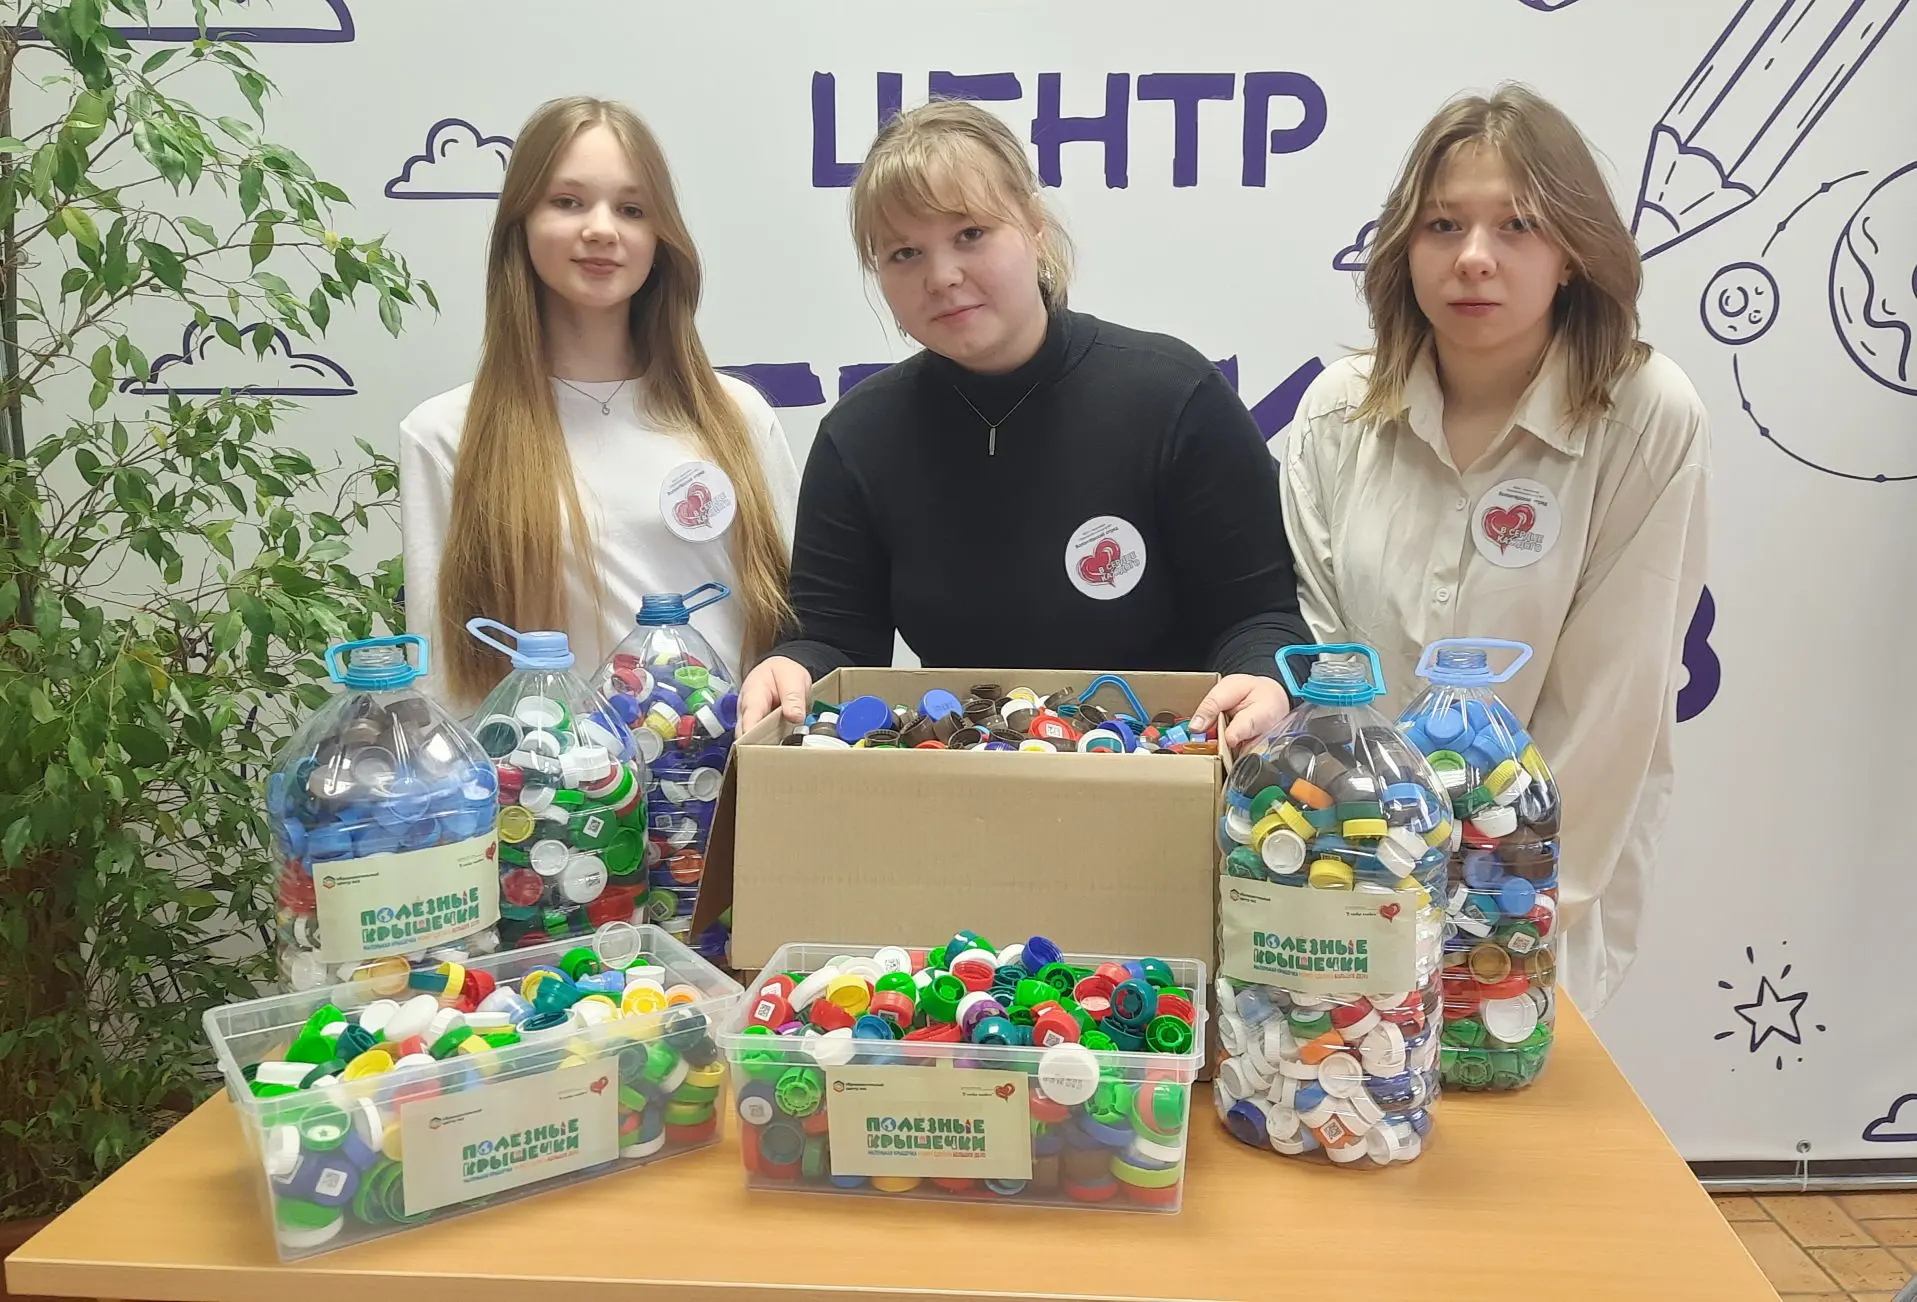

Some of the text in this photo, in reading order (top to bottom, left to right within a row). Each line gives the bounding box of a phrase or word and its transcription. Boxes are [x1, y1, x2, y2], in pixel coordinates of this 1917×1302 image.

[360, 886, 480, 927] ПОЛЕЗНЫЕ
[362, 903, 480, 944] КРЫШЕЧКИ
[1253, 931, 1368, 956] ПОЛЕЗНЫЕ
[1253, 948, 1368, 973] КРЫШЕЧКИ
[462, 1118, 579, 1161] ПОЛЕЗНЫЕ
[866, 1116, 985, 1134] ПОЛЕЗНЫЕ
[462, 1134, 580, 1177] КРЫШЕЧКИ
[867, 1133, 986, 1152] КРЫШЕЧКИ
